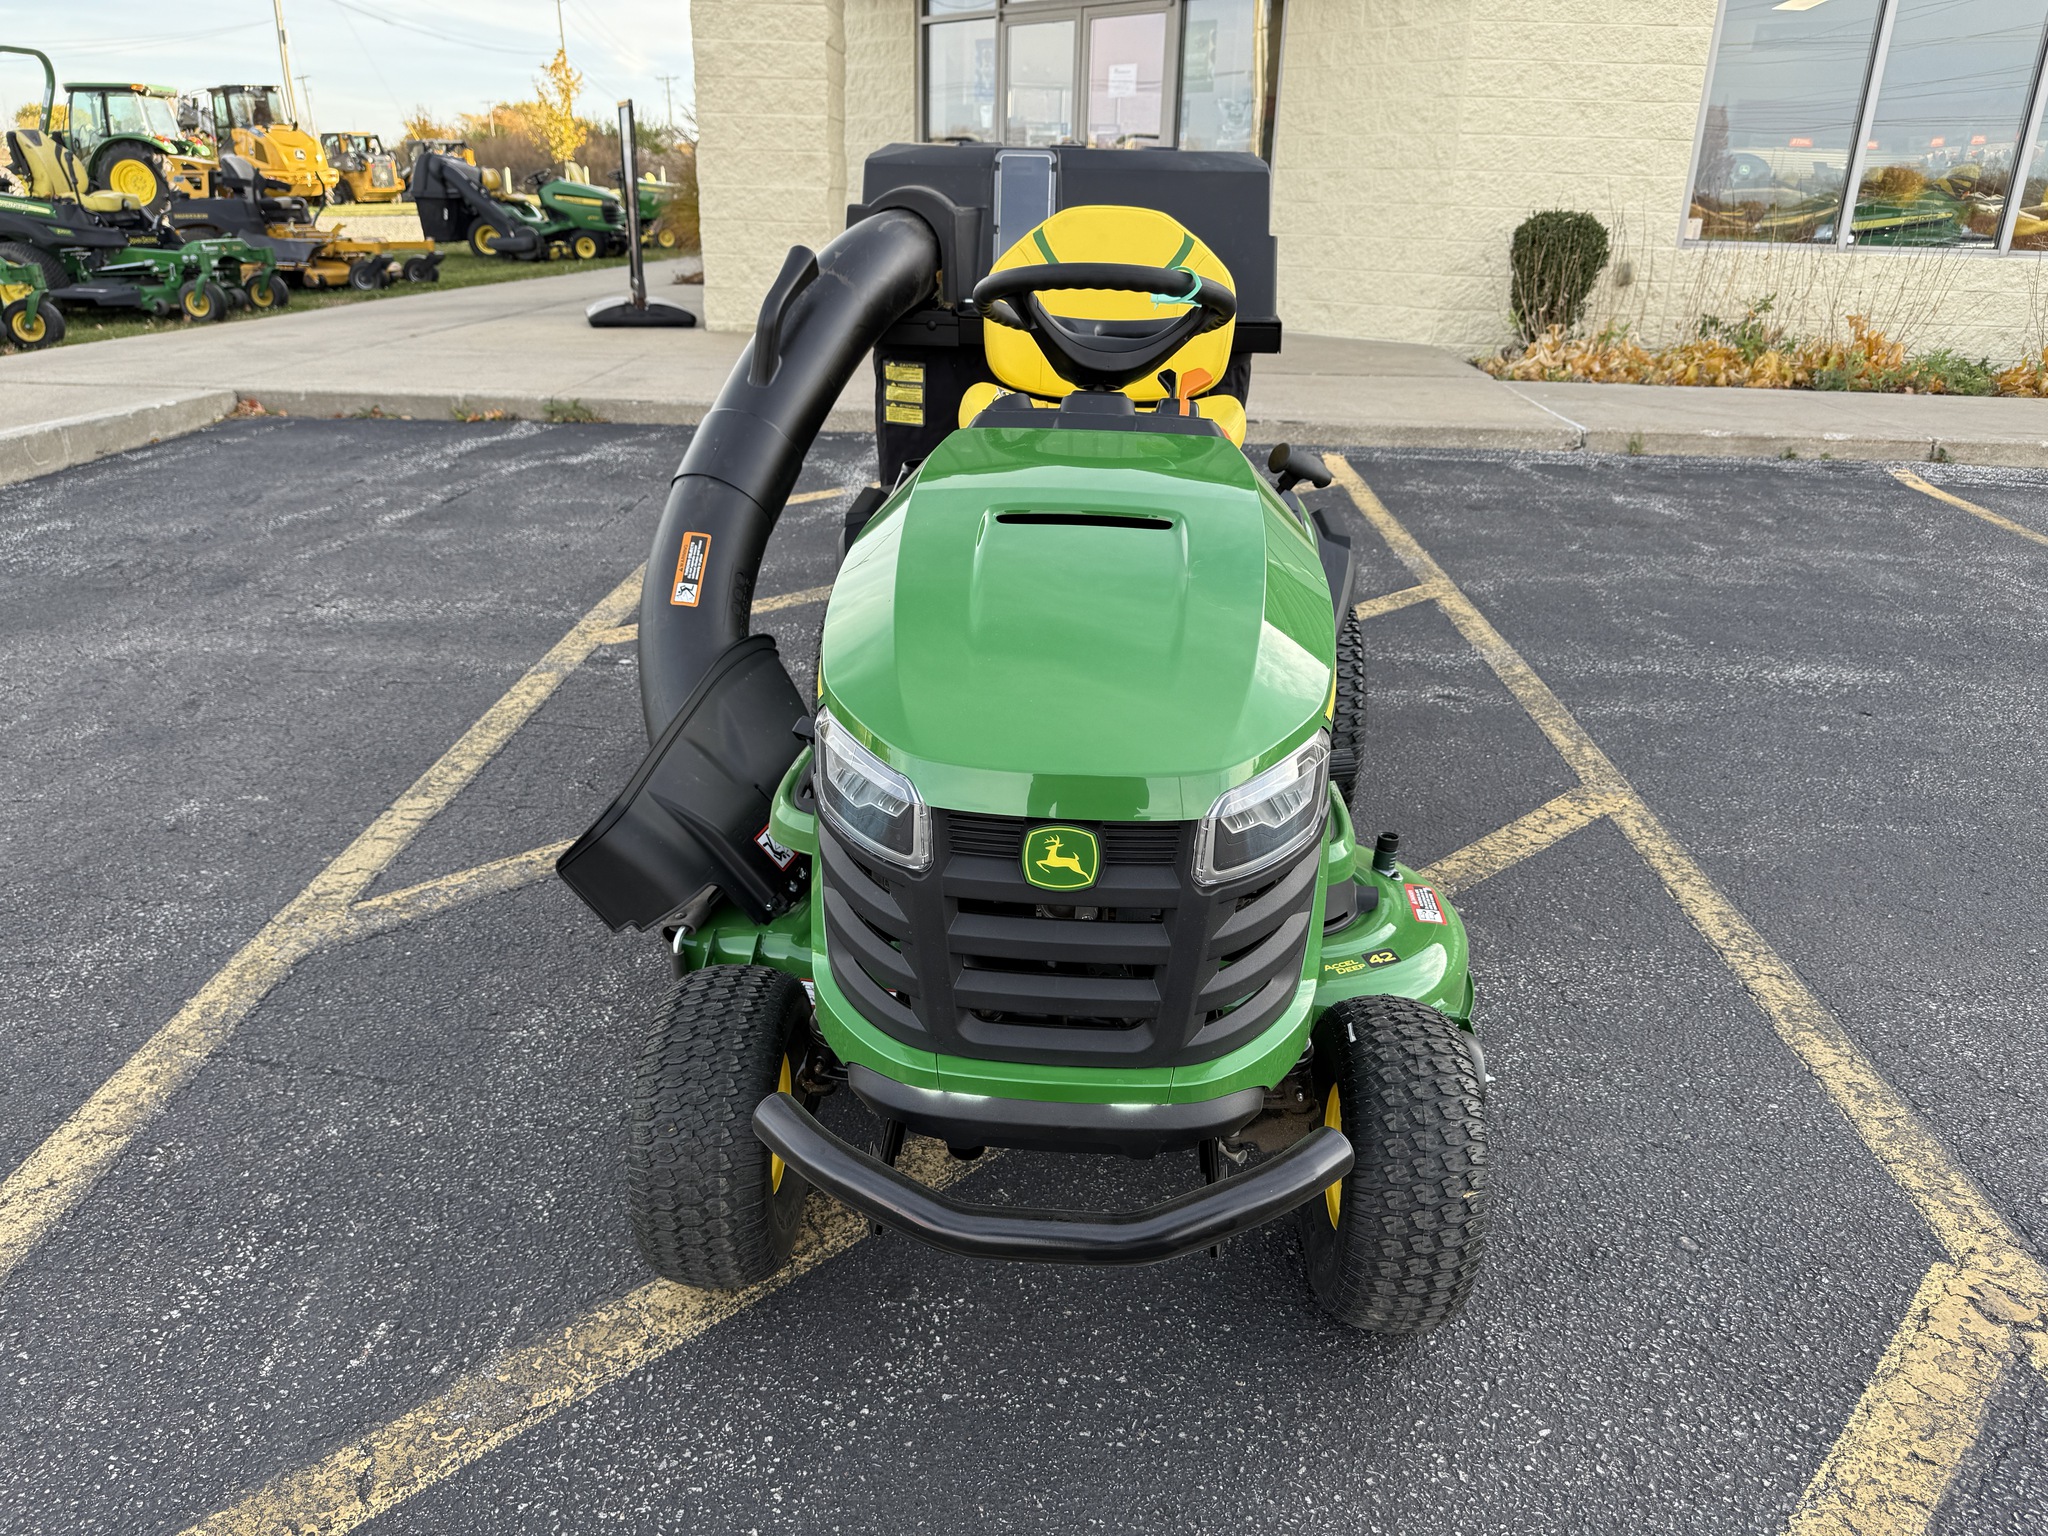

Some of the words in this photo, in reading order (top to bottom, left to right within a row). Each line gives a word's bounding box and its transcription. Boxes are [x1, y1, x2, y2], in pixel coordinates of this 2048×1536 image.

[1324, 960, 1359, 971] ACCEL
[1369, 952, 1397, 964] 42
[1336, 963, 1366, 975] DEEP
